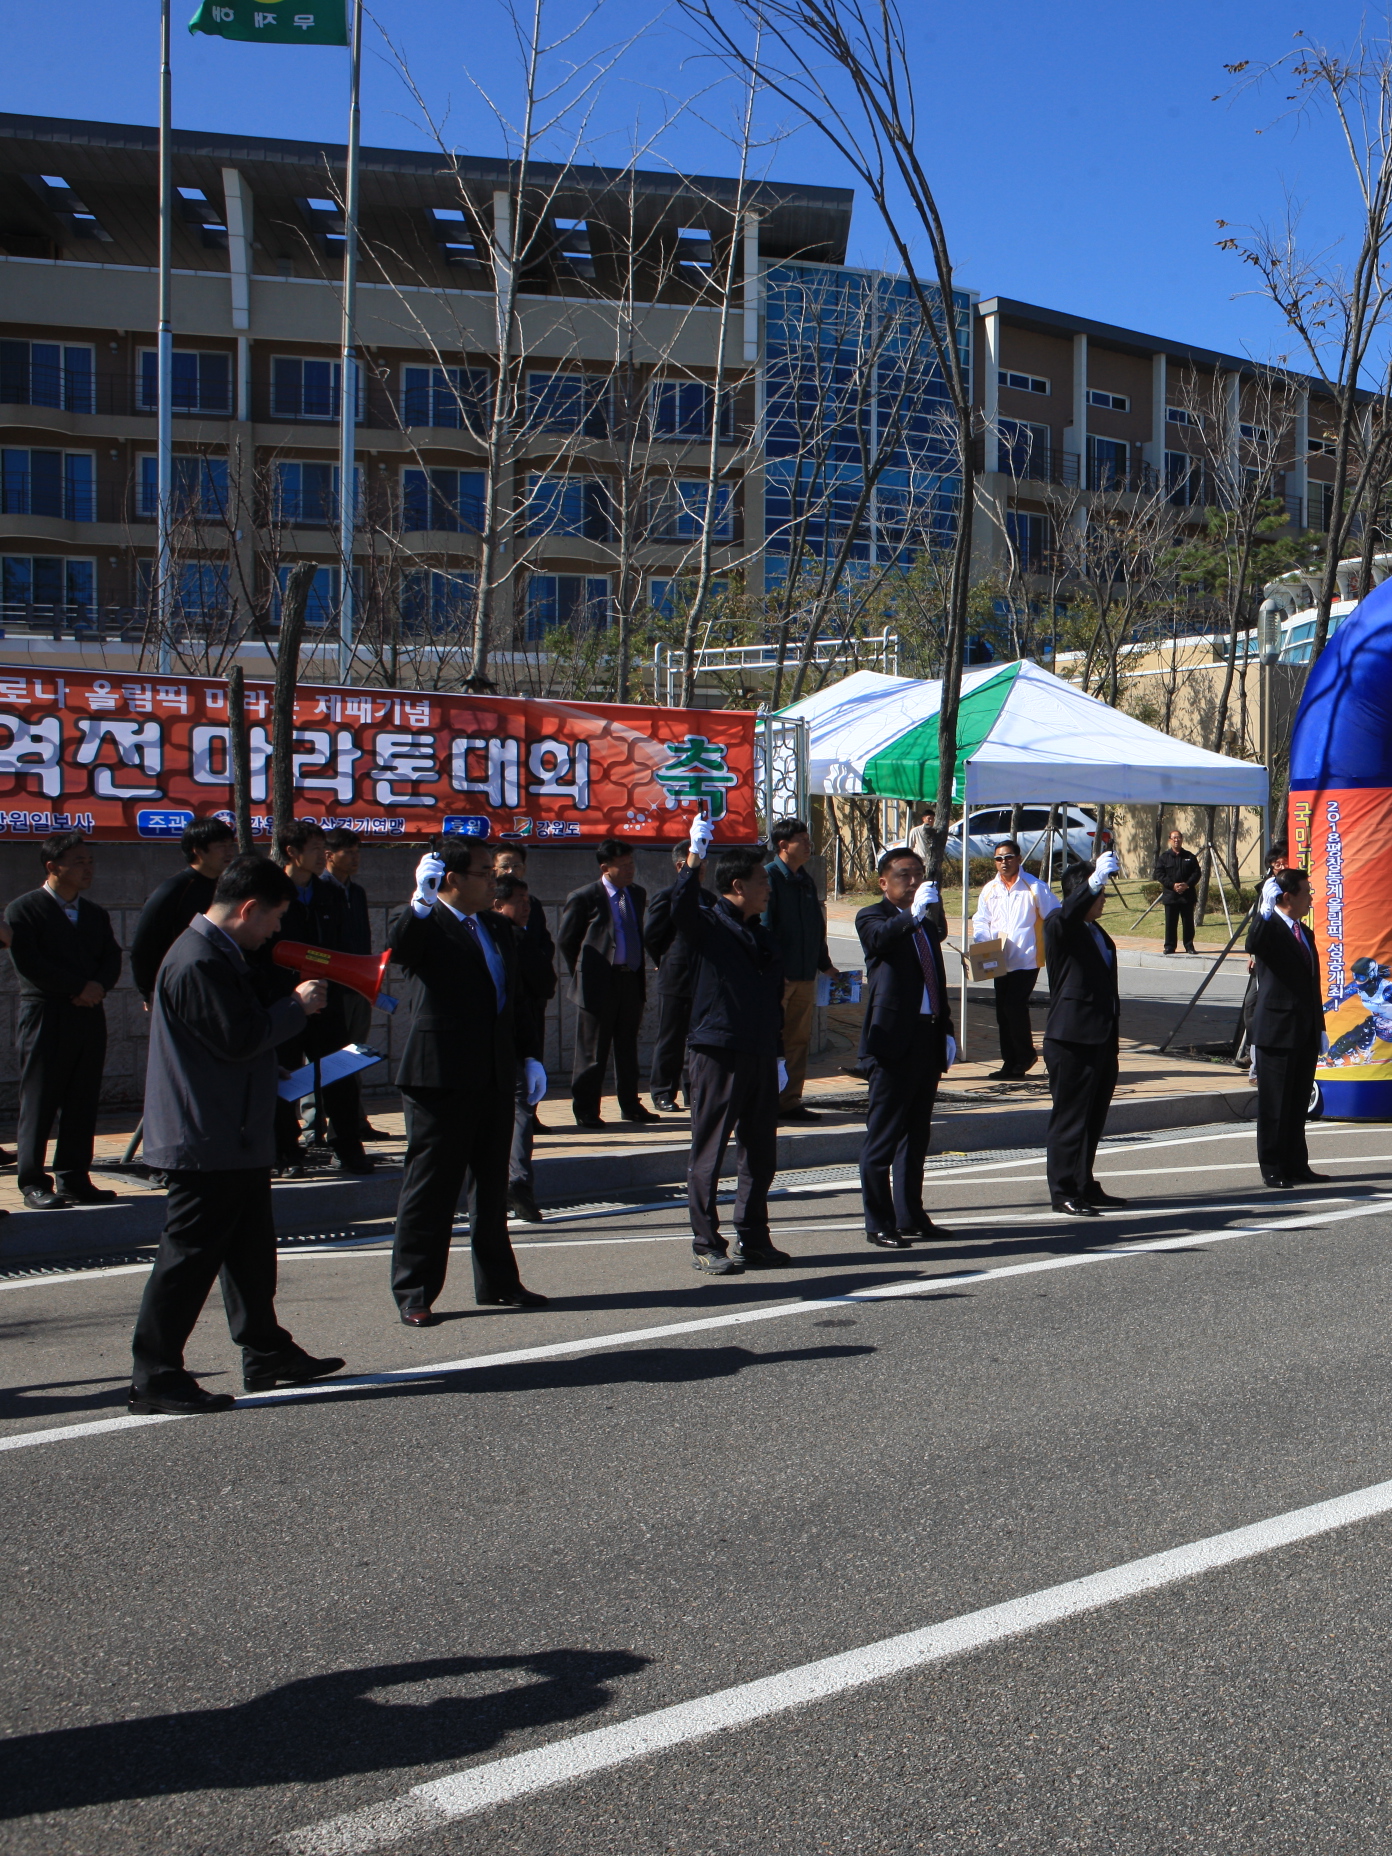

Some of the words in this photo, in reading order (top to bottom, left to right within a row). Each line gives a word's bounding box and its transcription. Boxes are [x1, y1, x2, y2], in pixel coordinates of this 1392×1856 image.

[0, 677, 69, 709] 로나
[85, 680, 188, 714] 올림픽
[204, 688, 300, 719] 마라
[314, 694, 431, 727] 제패기념
[0, 712, 166, 800] 역전
[190, 722, 591, 811] 마라톤대회
[654, 734, 738, 822] 축
[148, 814, 188, 834] 주관
[250, 816, 406, 837] 강원상경기연맹
[449, 818, 483, 836] 후원
[536, 820, 581, 838] 강원도
[1326, 801, 1344, 940] 2018평창동계올림픽
